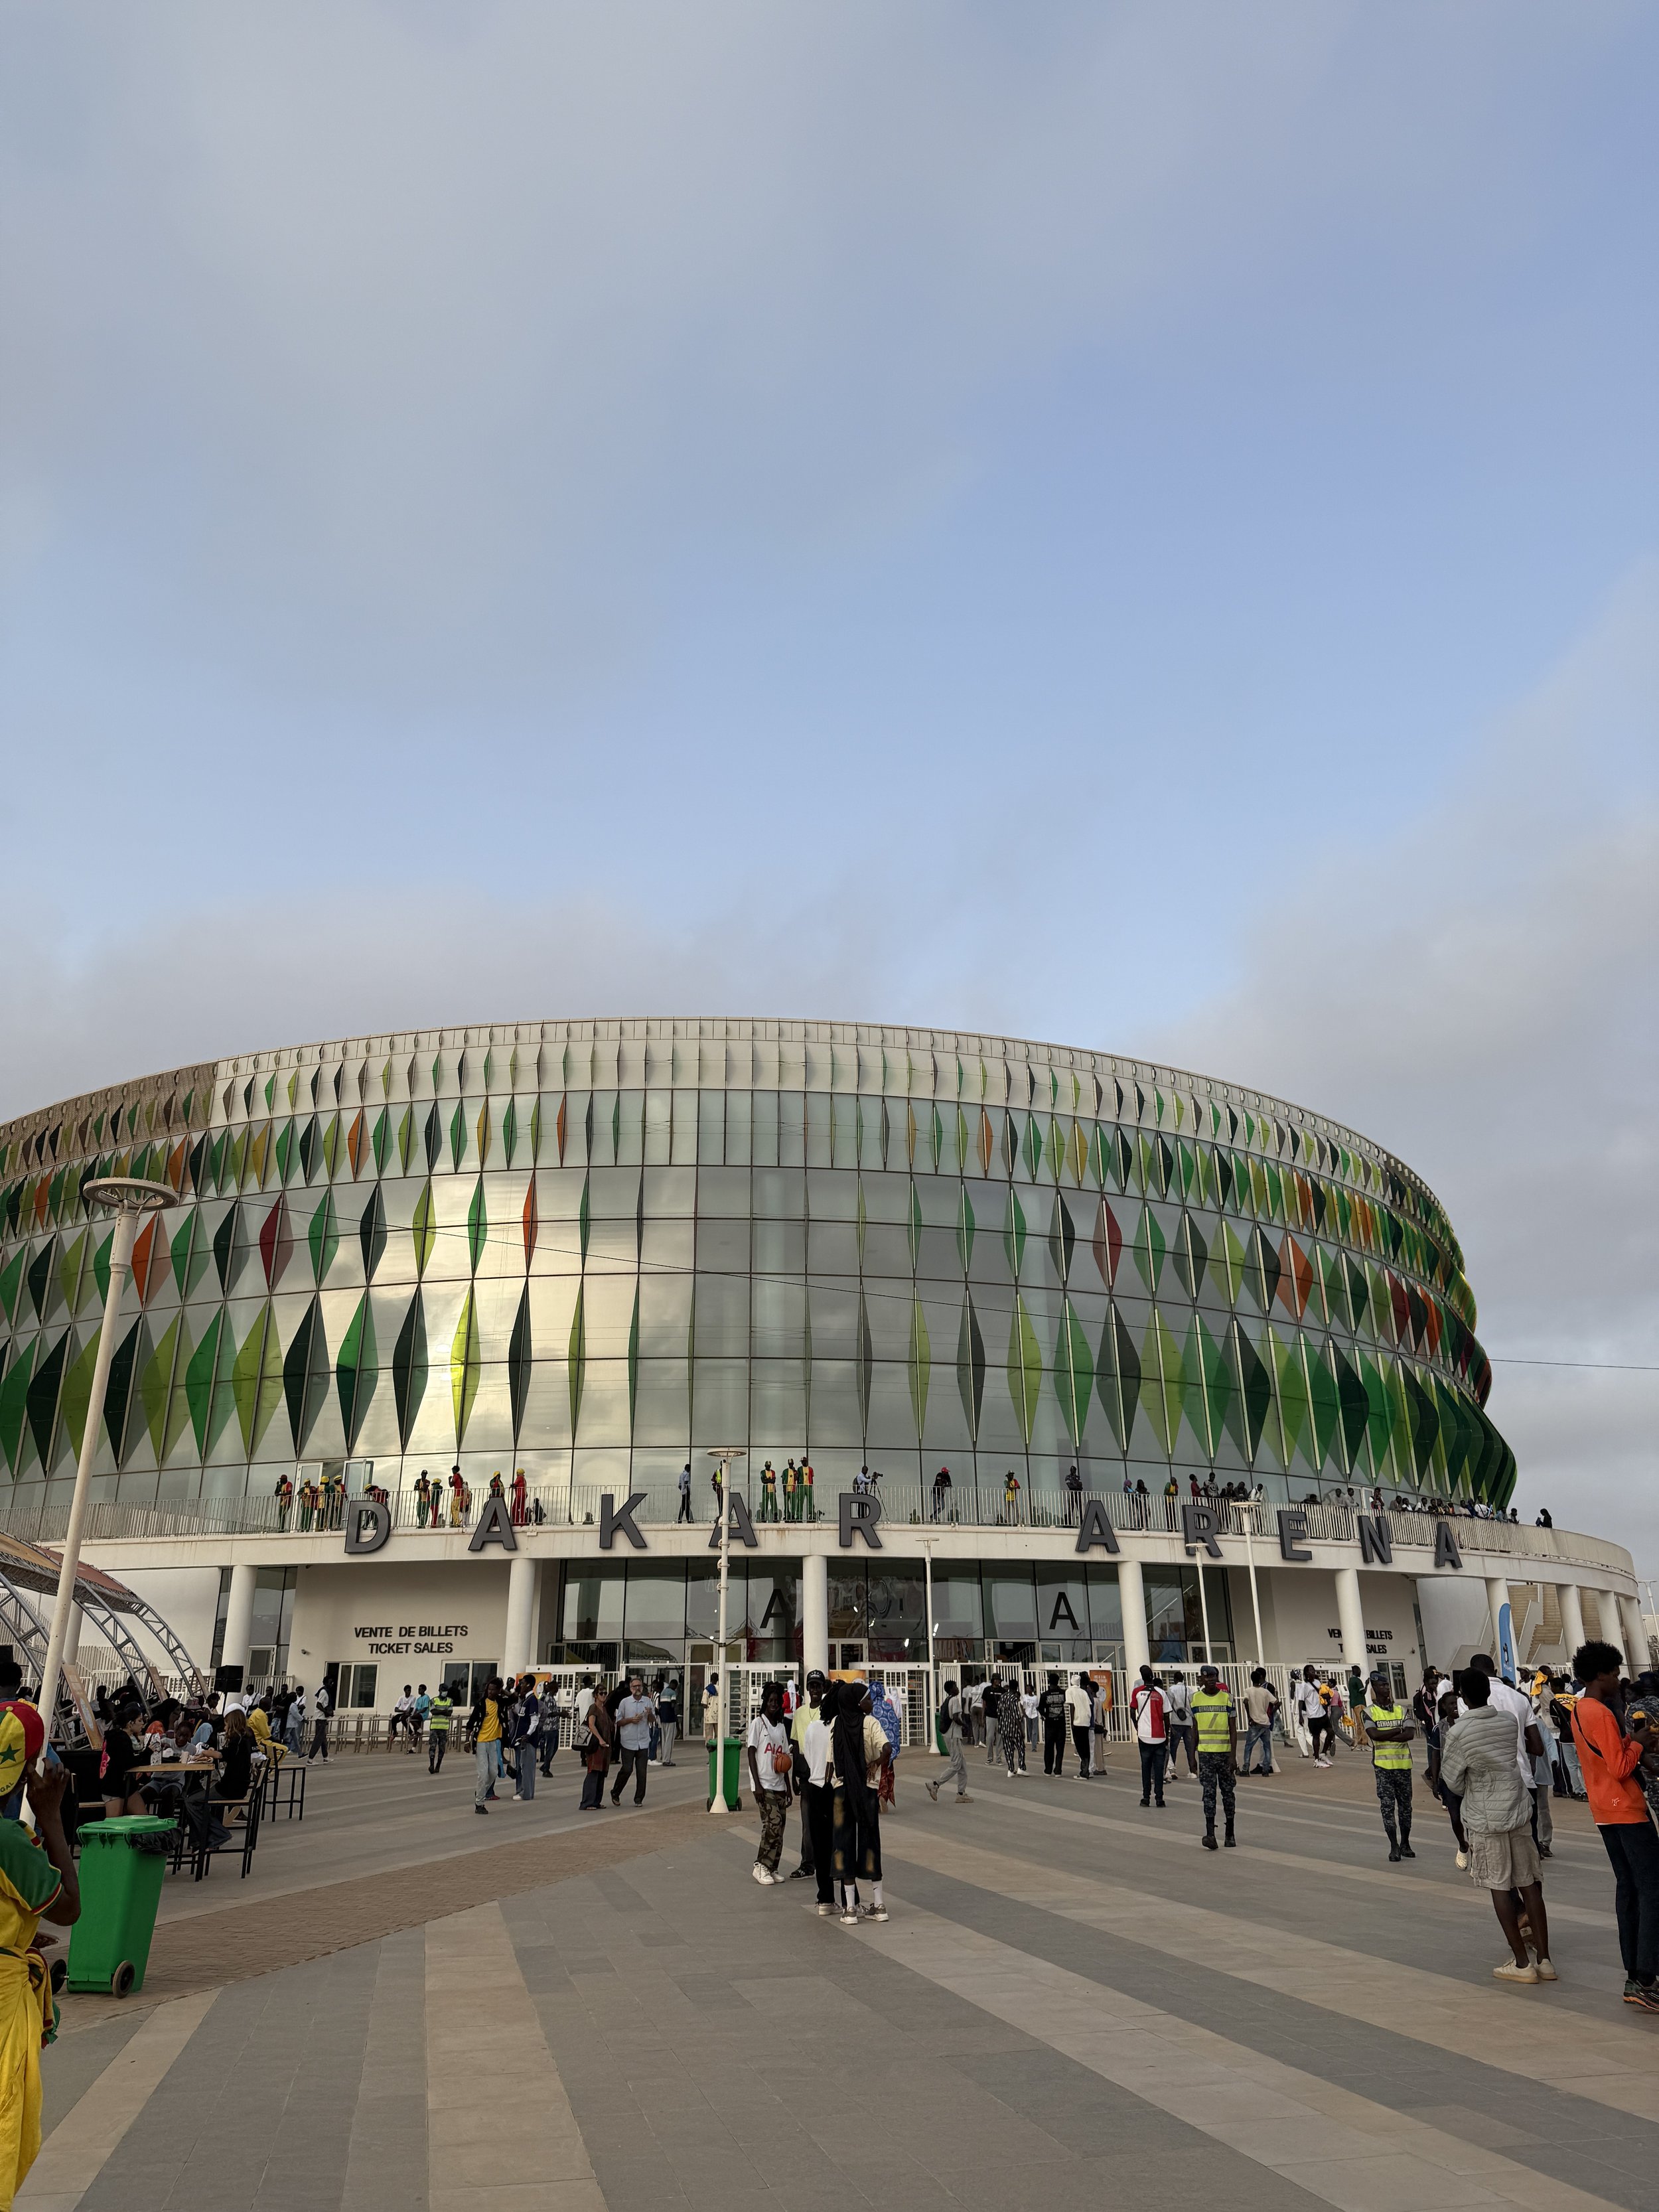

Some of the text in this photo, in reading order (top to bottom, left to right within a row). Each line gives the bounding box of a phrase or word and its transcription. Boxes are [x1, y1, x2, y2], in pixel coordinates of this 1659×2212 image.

[344, 1492, 1463, 1568] DAKAR ARENA
[1049, 1591, 1079, 1630] A
[354, 1625, 468, 1637] VENTE DE BILLETS
[1327, 1629, 1342, 1638] VEN
[1366, 1630, 1393, 1640] BILLETS
[368, 1642, 453, 1654] TICKET SALES
[1366, 1645, 1387, 1654] SALES
[764, 1743, 782, 1754] AIA
